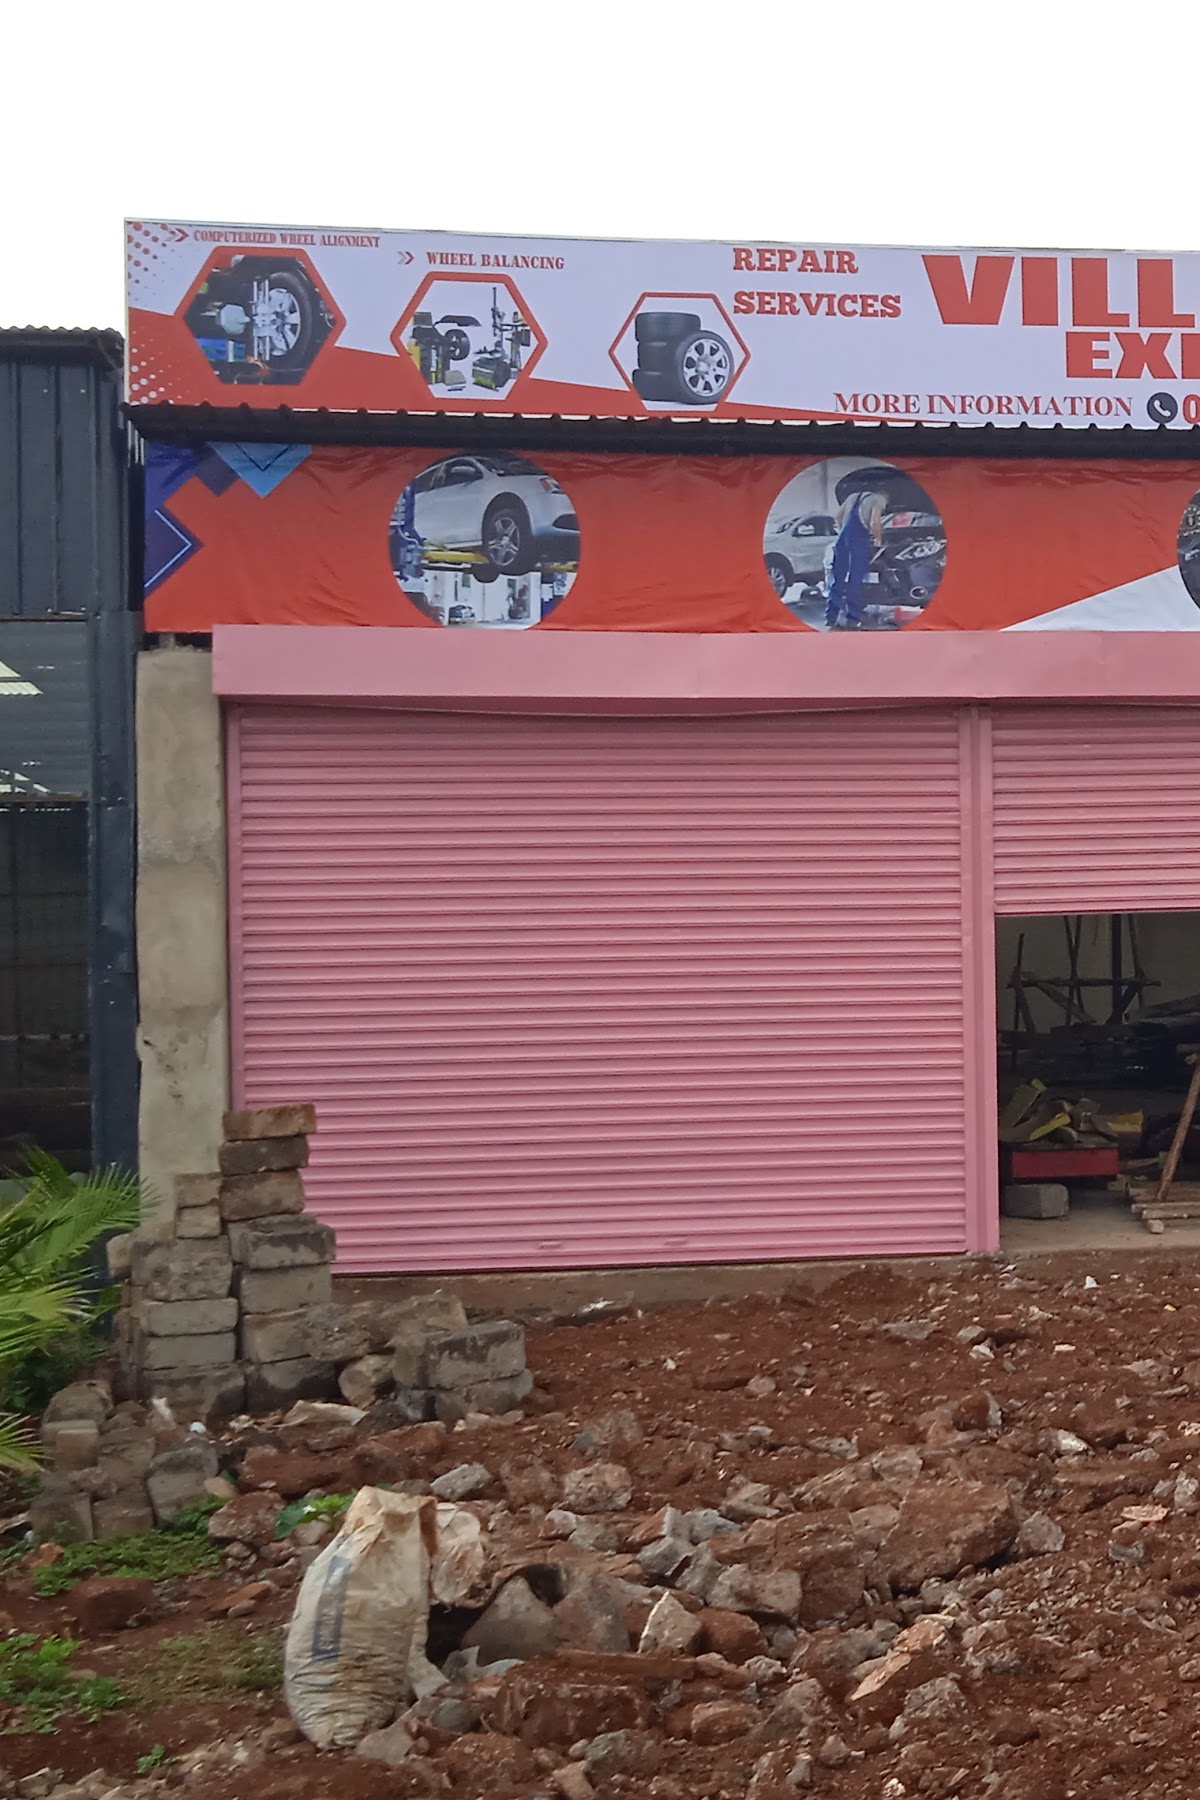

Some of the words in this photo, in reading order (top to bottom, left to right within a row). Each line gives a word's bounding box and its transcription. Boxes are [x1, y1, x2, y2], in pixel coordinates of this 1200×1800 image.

[194, 229, 277, 244] COMPUTERIZED
[280, 233, 316, 246] WHEEL
[319, 234, 380, 248] ALIGNMENT
[426, 252, 477, 267] WHEEL
[481, 253, 565, 270] BALANCING
[733, 247, 859, 274] REPAIR
[733, 290, 902, 318] SERVICES
[833, 392, 921, 414] MORE
[926, 395, 1134, 417] INFORMATION
